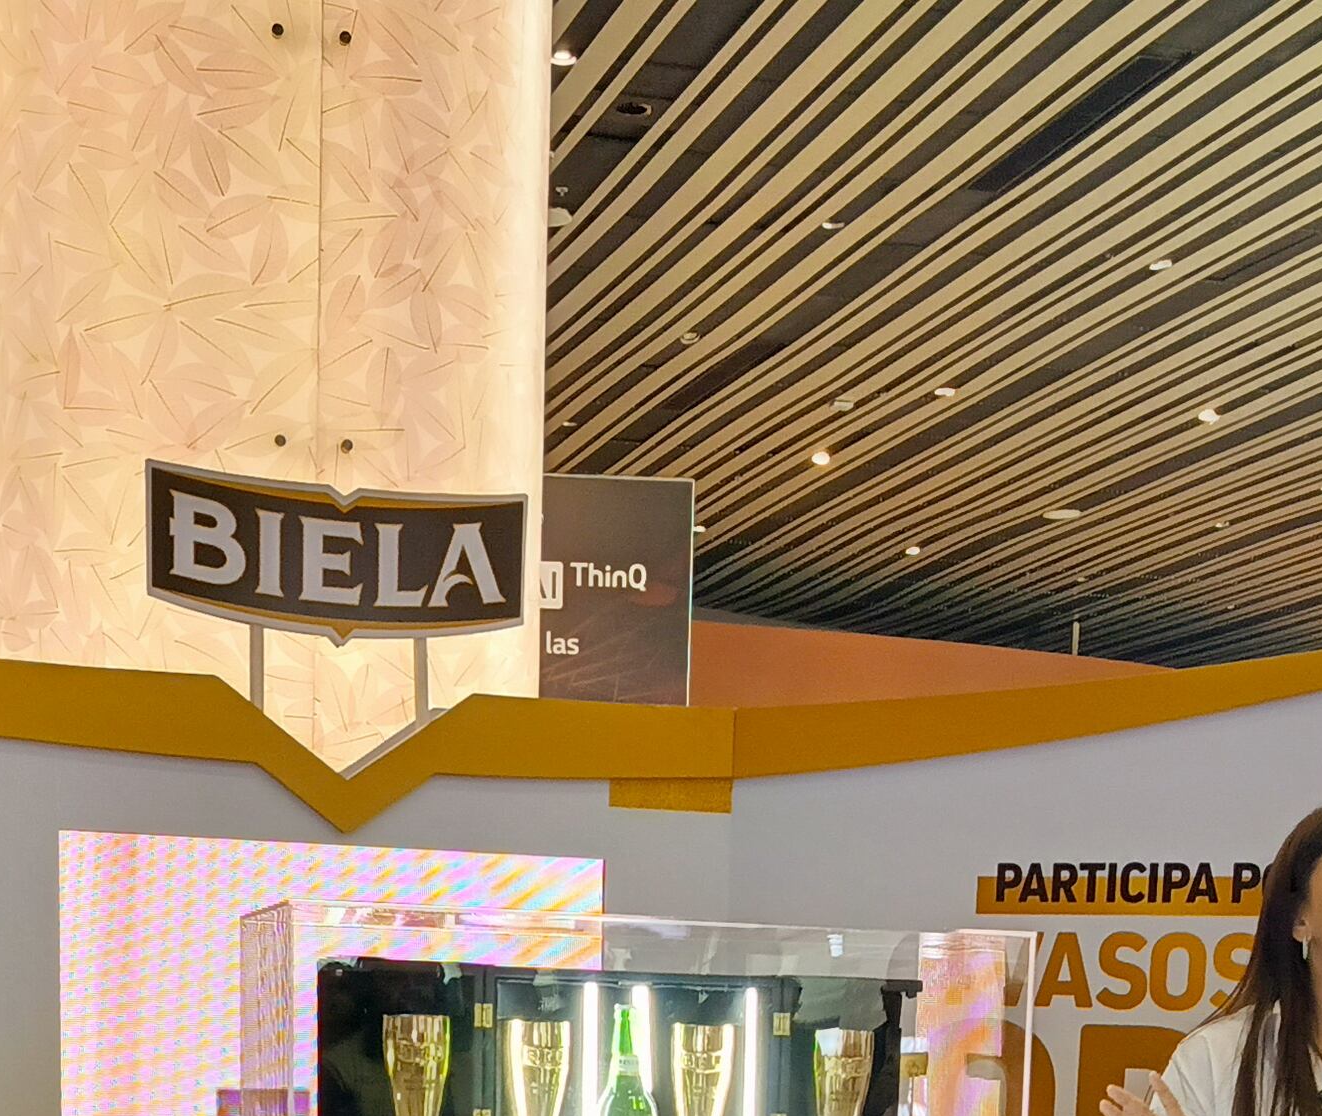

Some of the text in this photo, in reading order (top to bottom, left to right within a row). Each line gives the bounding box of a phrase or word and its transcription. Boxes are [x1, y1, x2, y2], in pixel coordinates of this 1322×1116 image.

[168, 488, 507, 608] BIELA
[569, 562, 647, 592] ThinQ
[545, 631, 580, 655] las
[994, 862, 1271, 904] PARTICIPA P
